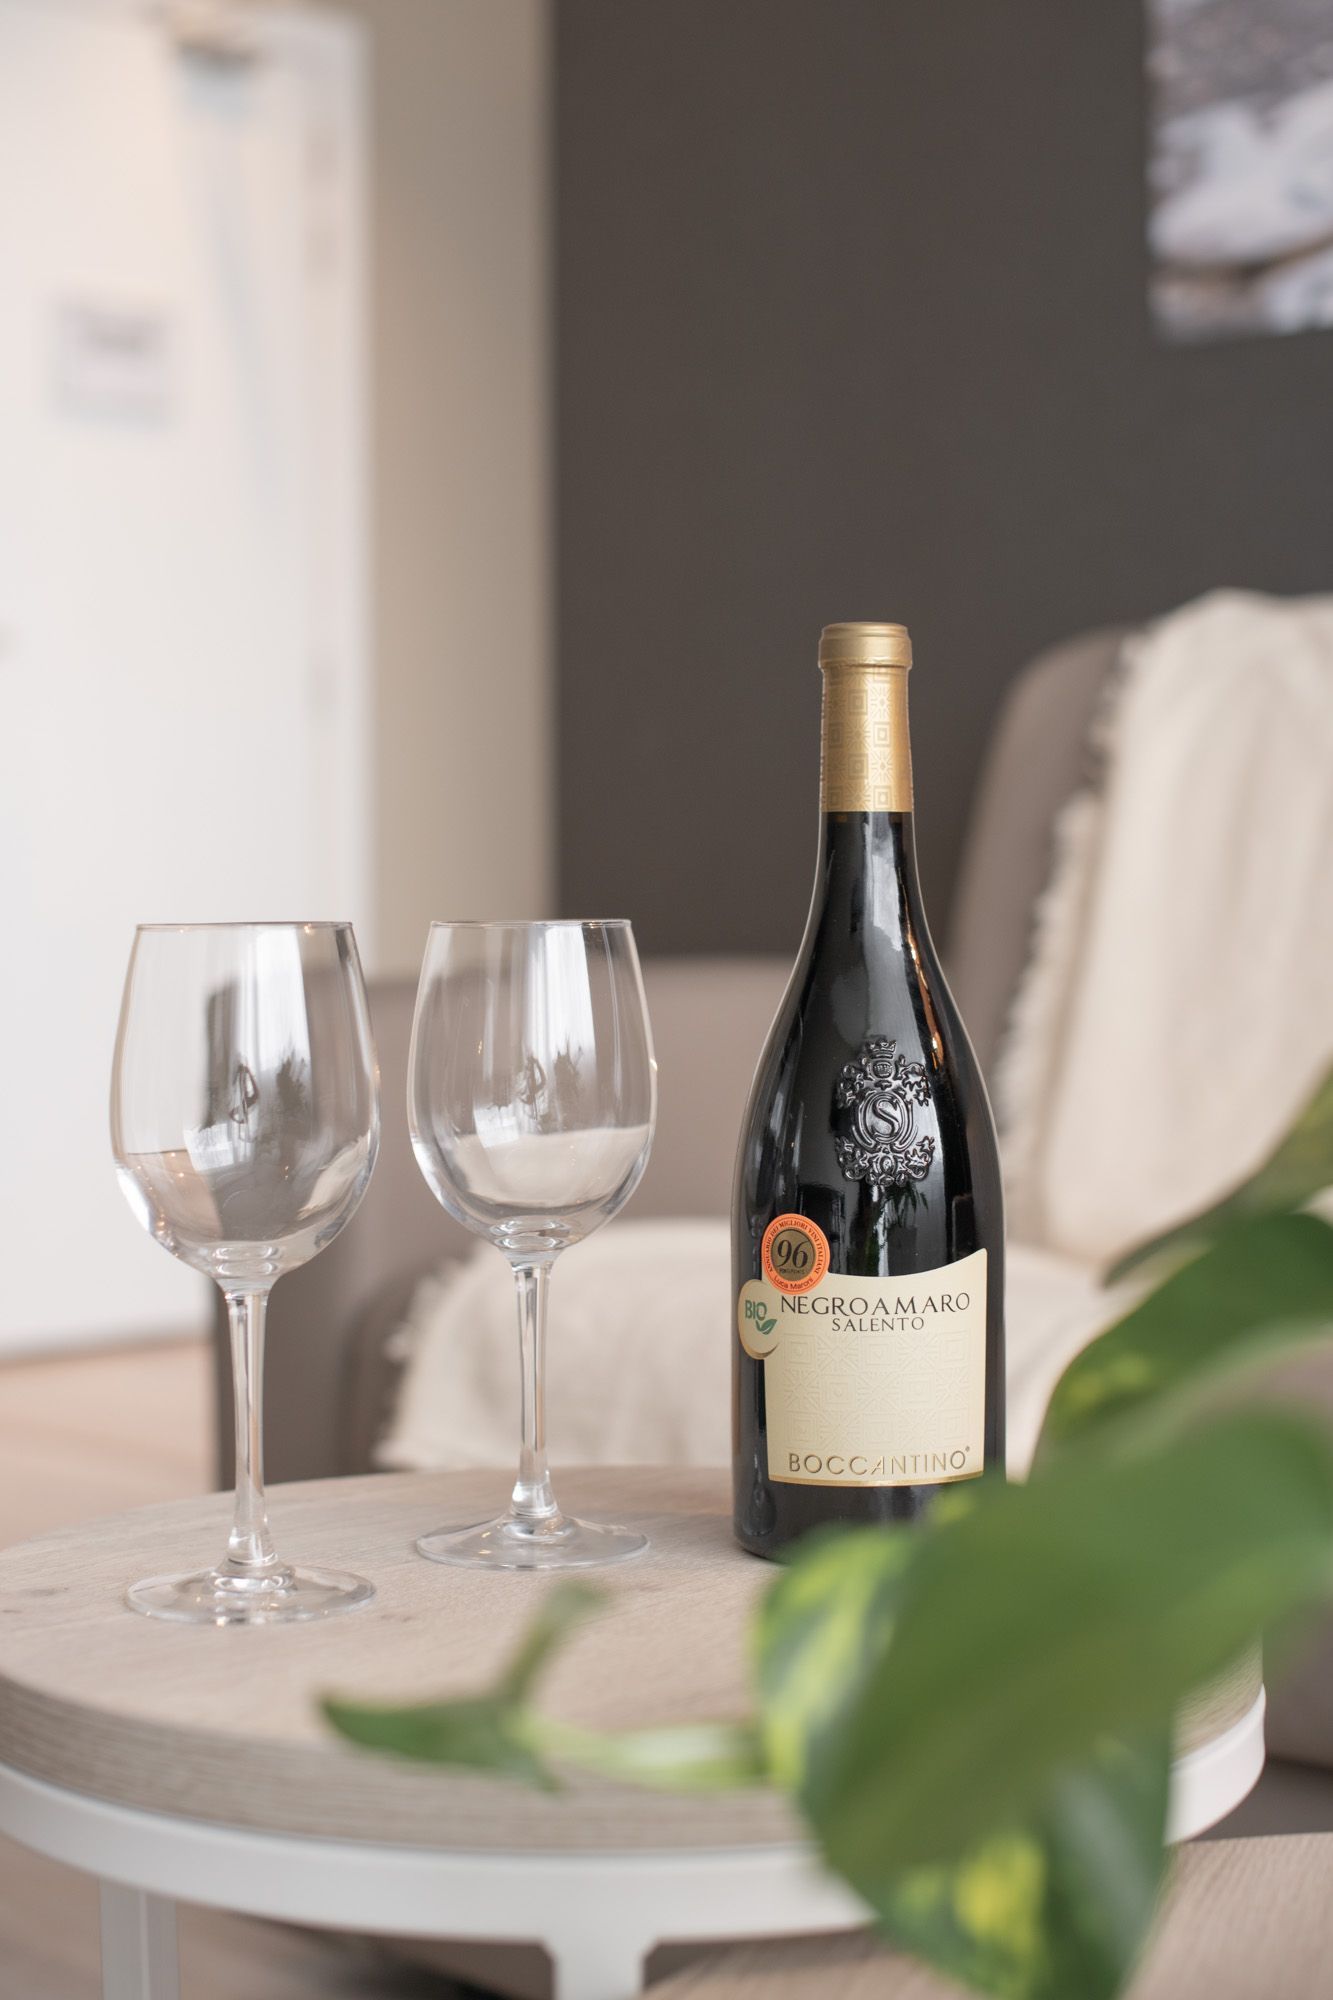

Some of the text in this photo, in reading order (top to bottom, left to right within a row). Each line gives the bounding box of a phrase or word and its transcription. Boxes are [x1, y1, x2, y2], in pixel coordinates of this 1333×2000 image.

[771, 1226, 779, 1237] DEI
[779, 1220, 808, 1230] MIGLIORI
[808, 1228, 819, 1243] VINI
[814, 1242, 823, 1274] ITALIANI
[777, 1239, 810, 1269] 96
[774, 1275, 814, 1290] Luca Maroni
[745, 1299, 767, 1321] BIO
[781, 1292, 970, 1316] NEGROAMARO
[831, 1316, 925, 1332] SALENTO
[788, 1449, 967, 1476] BOCCANTINO
